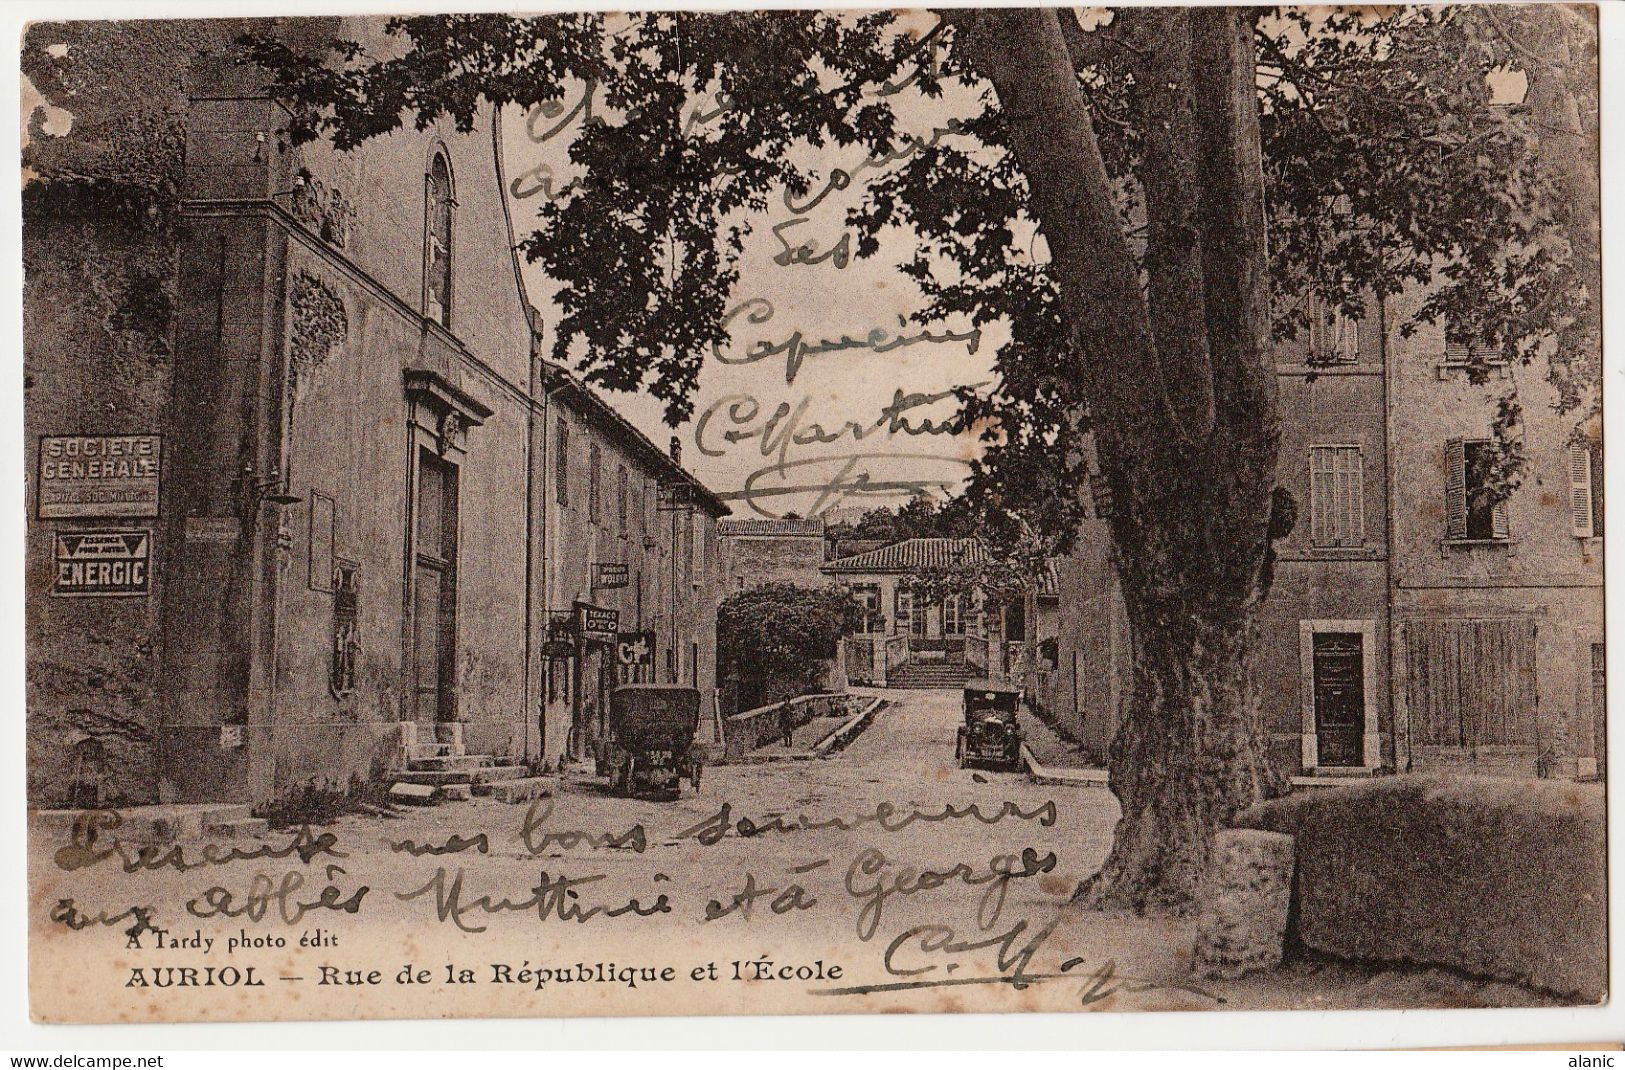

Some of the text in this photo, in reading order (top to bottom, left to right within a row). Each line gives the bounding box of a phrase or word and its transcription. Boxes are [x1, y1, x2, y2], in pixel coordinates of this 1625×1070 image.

[84, 536, 121, 544] ESSENCE
[58, 561, 145, 586] ENERGIC
[588, 610, 617, 620] TEXACO
[520, 800, 648, 856] bons
[844, 848, 1058, 942] Georges
